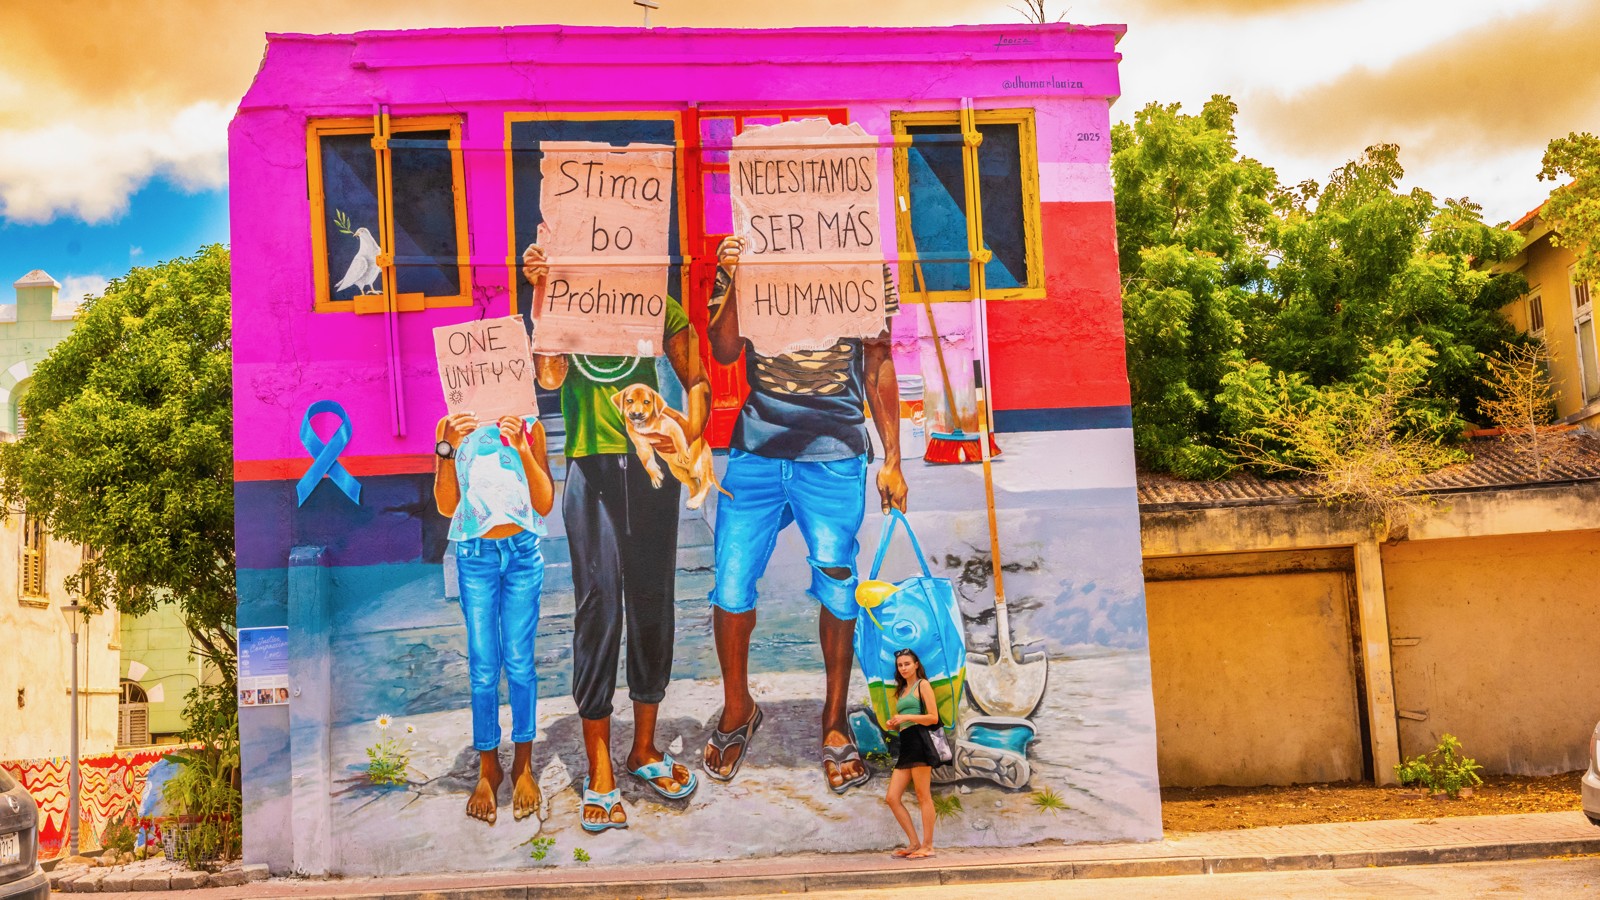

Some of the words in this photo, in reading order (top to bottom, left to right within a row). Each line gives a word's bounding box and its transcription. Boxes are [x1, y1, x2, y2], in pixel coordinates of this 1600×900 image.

[1077, 132, 1100, 142] 2025
[738, 156, 873, 196] NECESITAMOS
[591, 216, 633, 252] bo
[750, 213, 805, 255] SER
[817, 204, 874, 250] MÁS
[547, 279, 664, 317] Próhimo
[754, 279, 878, 316] HUMANOS
[448, 325, 507, 355] ONE
